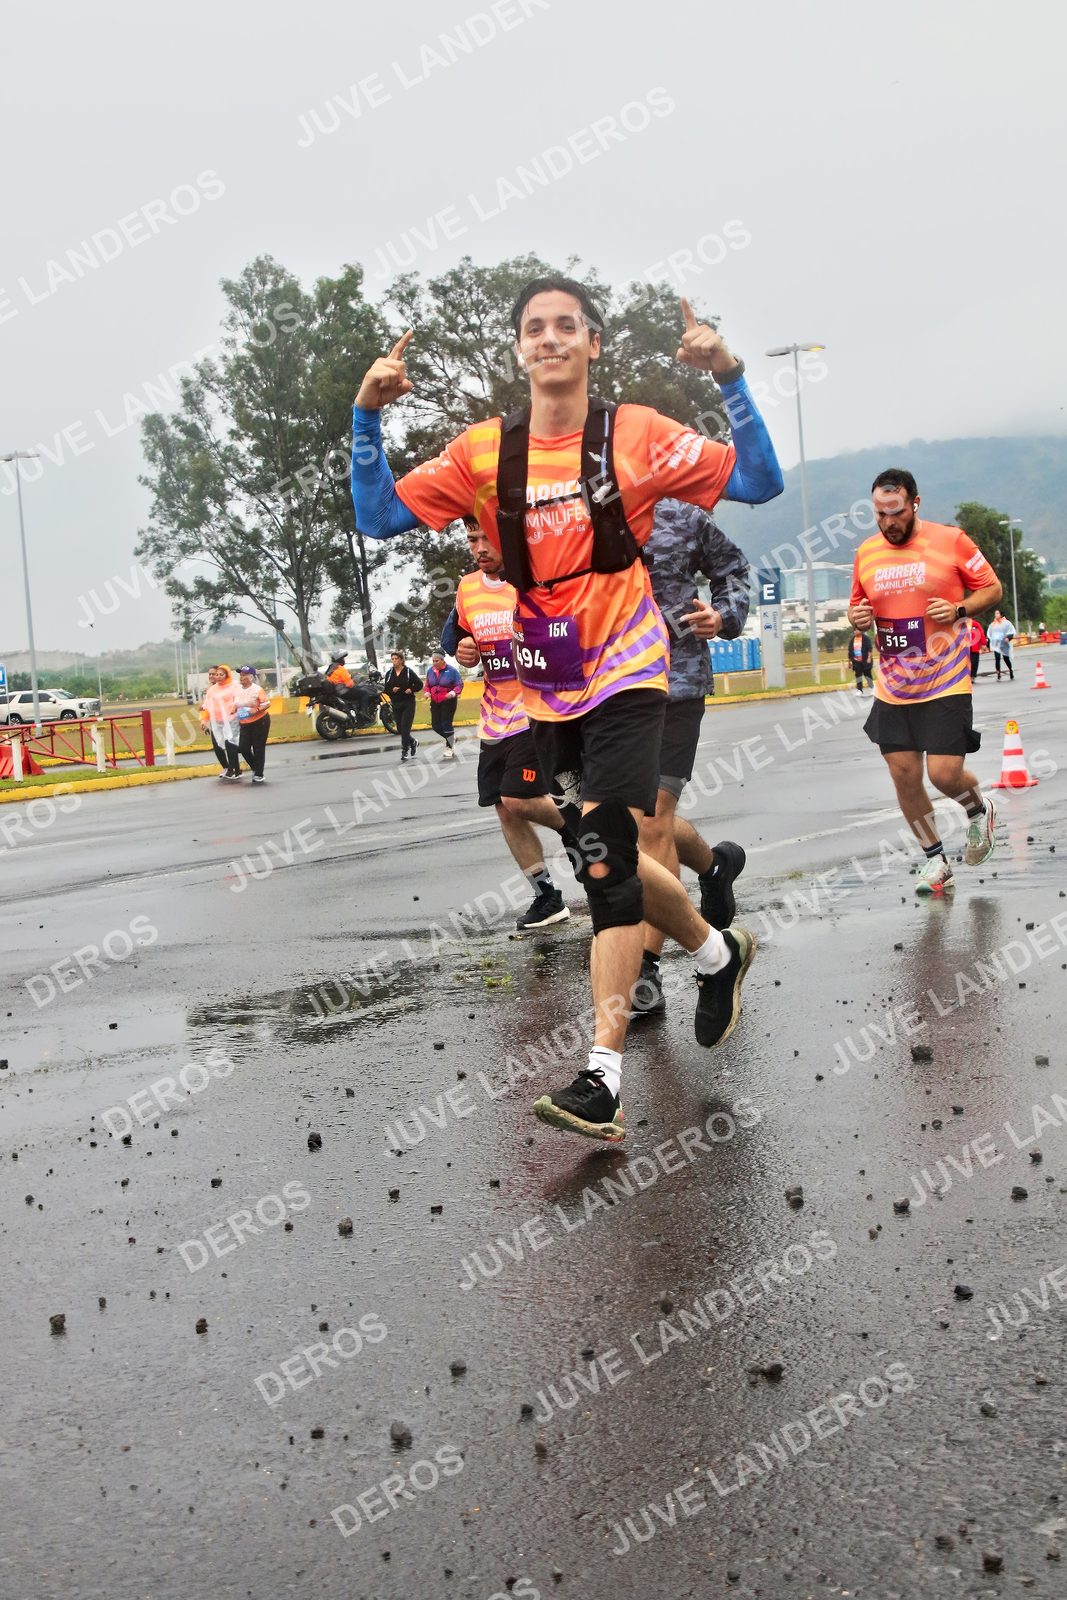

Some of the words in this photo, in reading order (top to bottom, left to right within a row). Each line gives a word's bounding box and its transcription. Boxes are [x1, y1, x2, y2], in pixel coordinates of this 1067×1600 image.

[526, 506, 583, 528] MNILIFE
[875, 561, 926, 582] CARRERA
[763, 583, 776, 600] E
[548, 621, 568, 638] 15K
[908, 621, 919, 629] 15K
[886, 635, 908, 647] 515
[487, 657, 510, 670] 194
